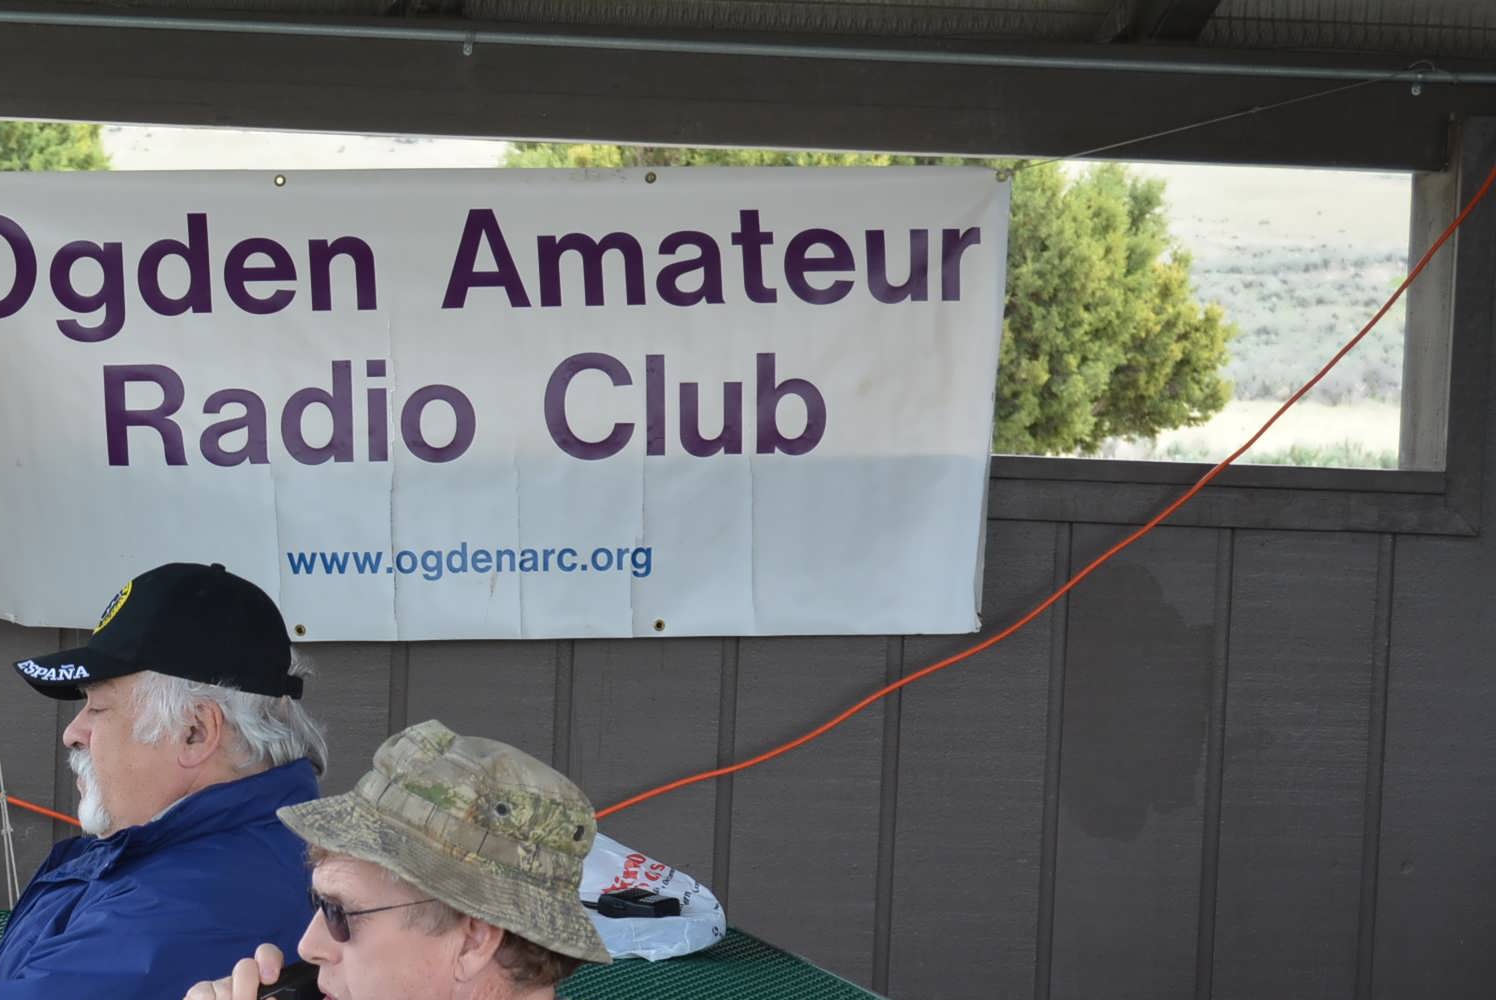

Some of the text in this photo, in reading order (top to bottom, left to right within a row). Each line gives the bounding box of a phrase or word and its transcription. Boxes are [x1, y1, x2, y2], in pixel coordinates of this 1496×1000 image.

[443, 208, 981, 310] Amateur
[103, 352, 827, 467] Radio Club
[287, 543, 653, 581] www.ogdenarc.org
[17, 659, 90, 680] ESPAÑA
